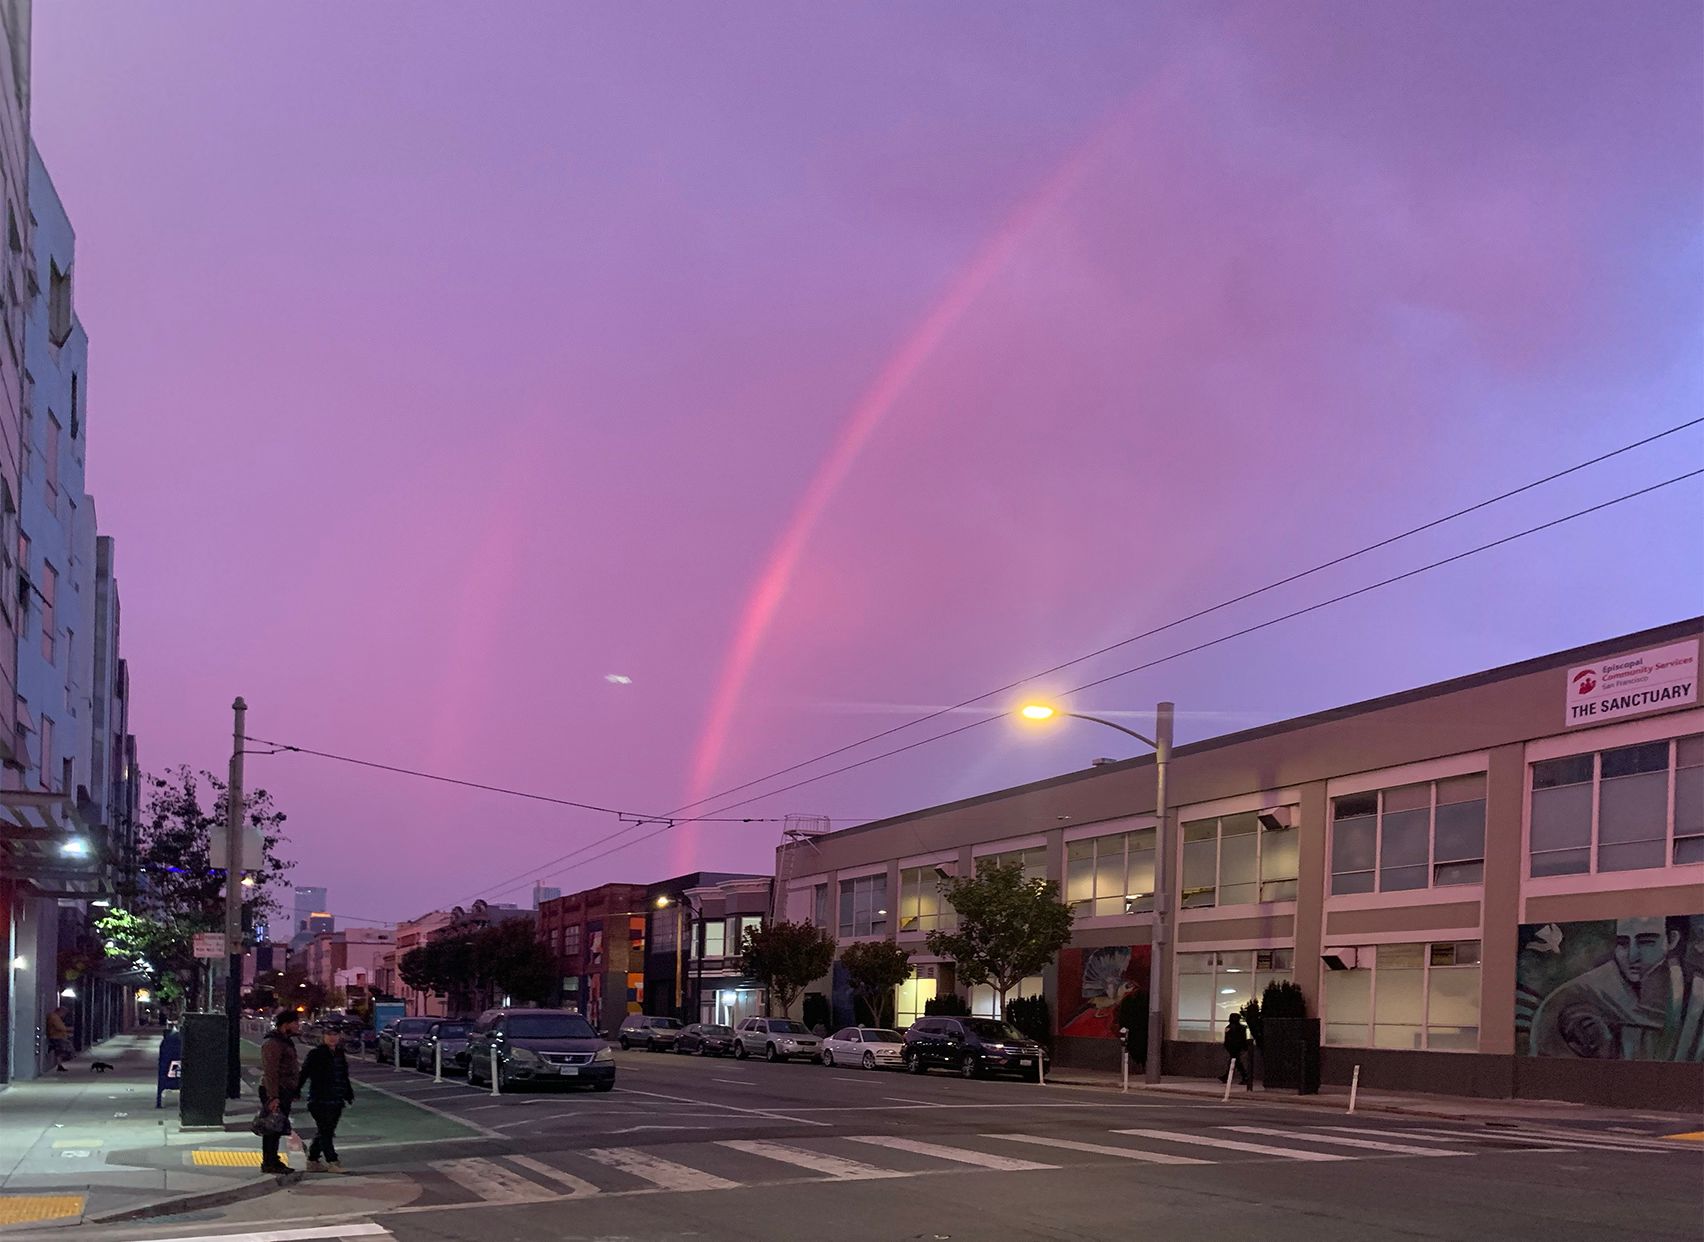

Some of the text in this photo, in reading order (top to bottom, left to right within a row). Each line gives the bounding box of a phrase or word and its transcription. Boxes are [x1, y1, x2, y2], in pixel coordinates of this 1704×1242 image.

[1602, 658, 1643, 674] Episcopal
[1602, 656, 1693, 682] Community Services
[1602, 676, 1649, 690] San Francisco
[1571, 683, 1692, 718] THE SANCTUARY
